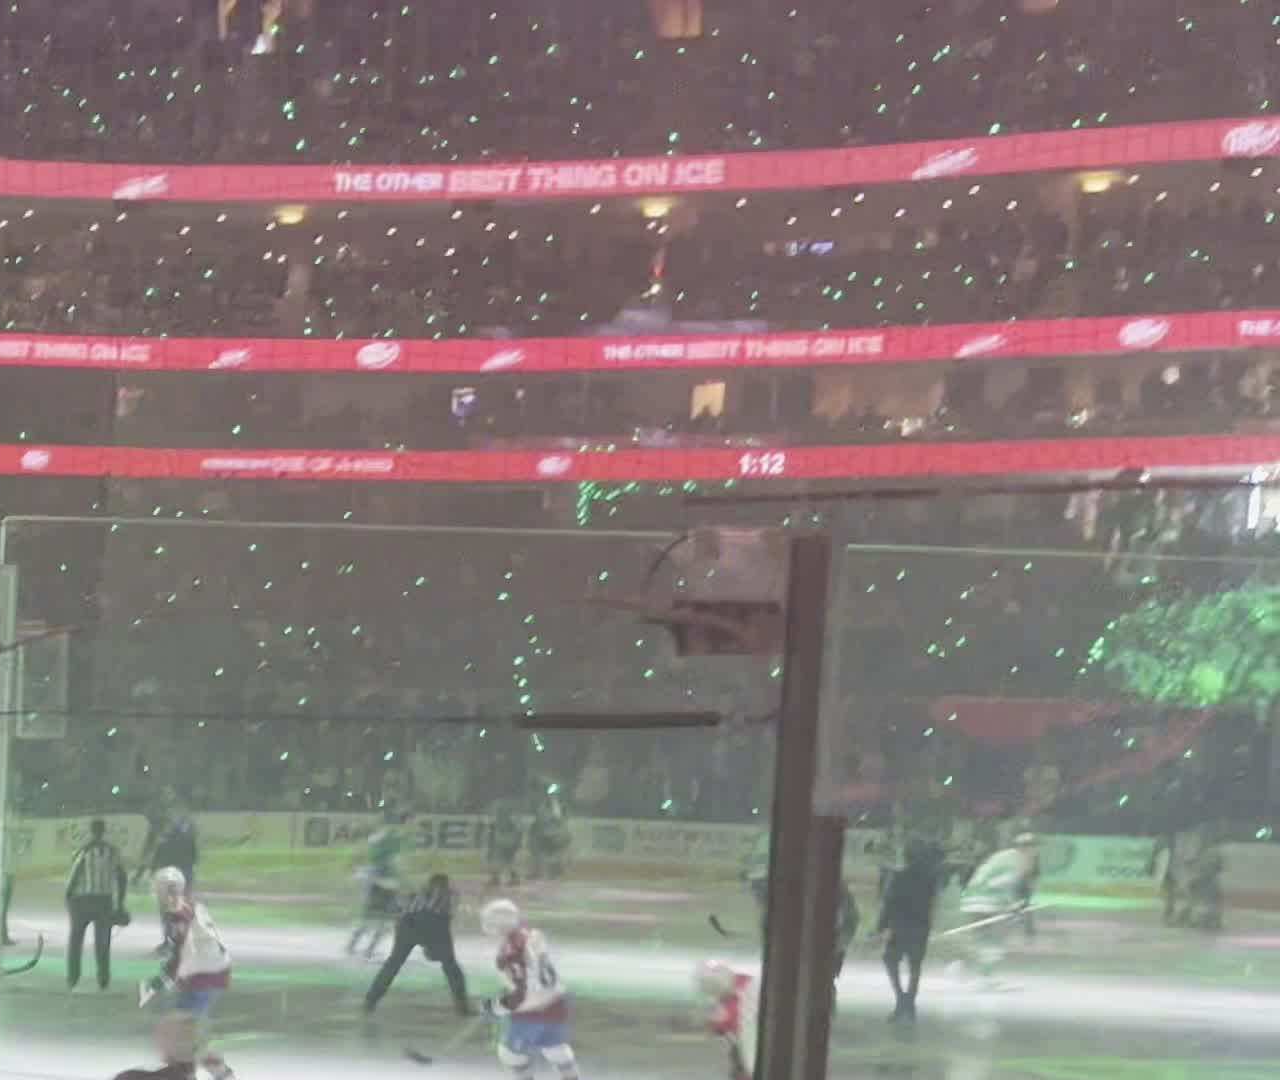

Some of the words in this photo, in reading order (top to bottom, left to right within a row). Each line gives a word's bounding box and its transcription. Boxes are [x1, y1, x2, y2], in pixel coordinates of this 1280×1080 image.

[335, 171, 372, 192] THE
[448, 167, 520, 193] BEST
[527, 164, 616, 192] THING
[624, 161, 669, 187] ON
[673, 158, 725, 186] ICE
[739, 453, 785, 475] 1:12
